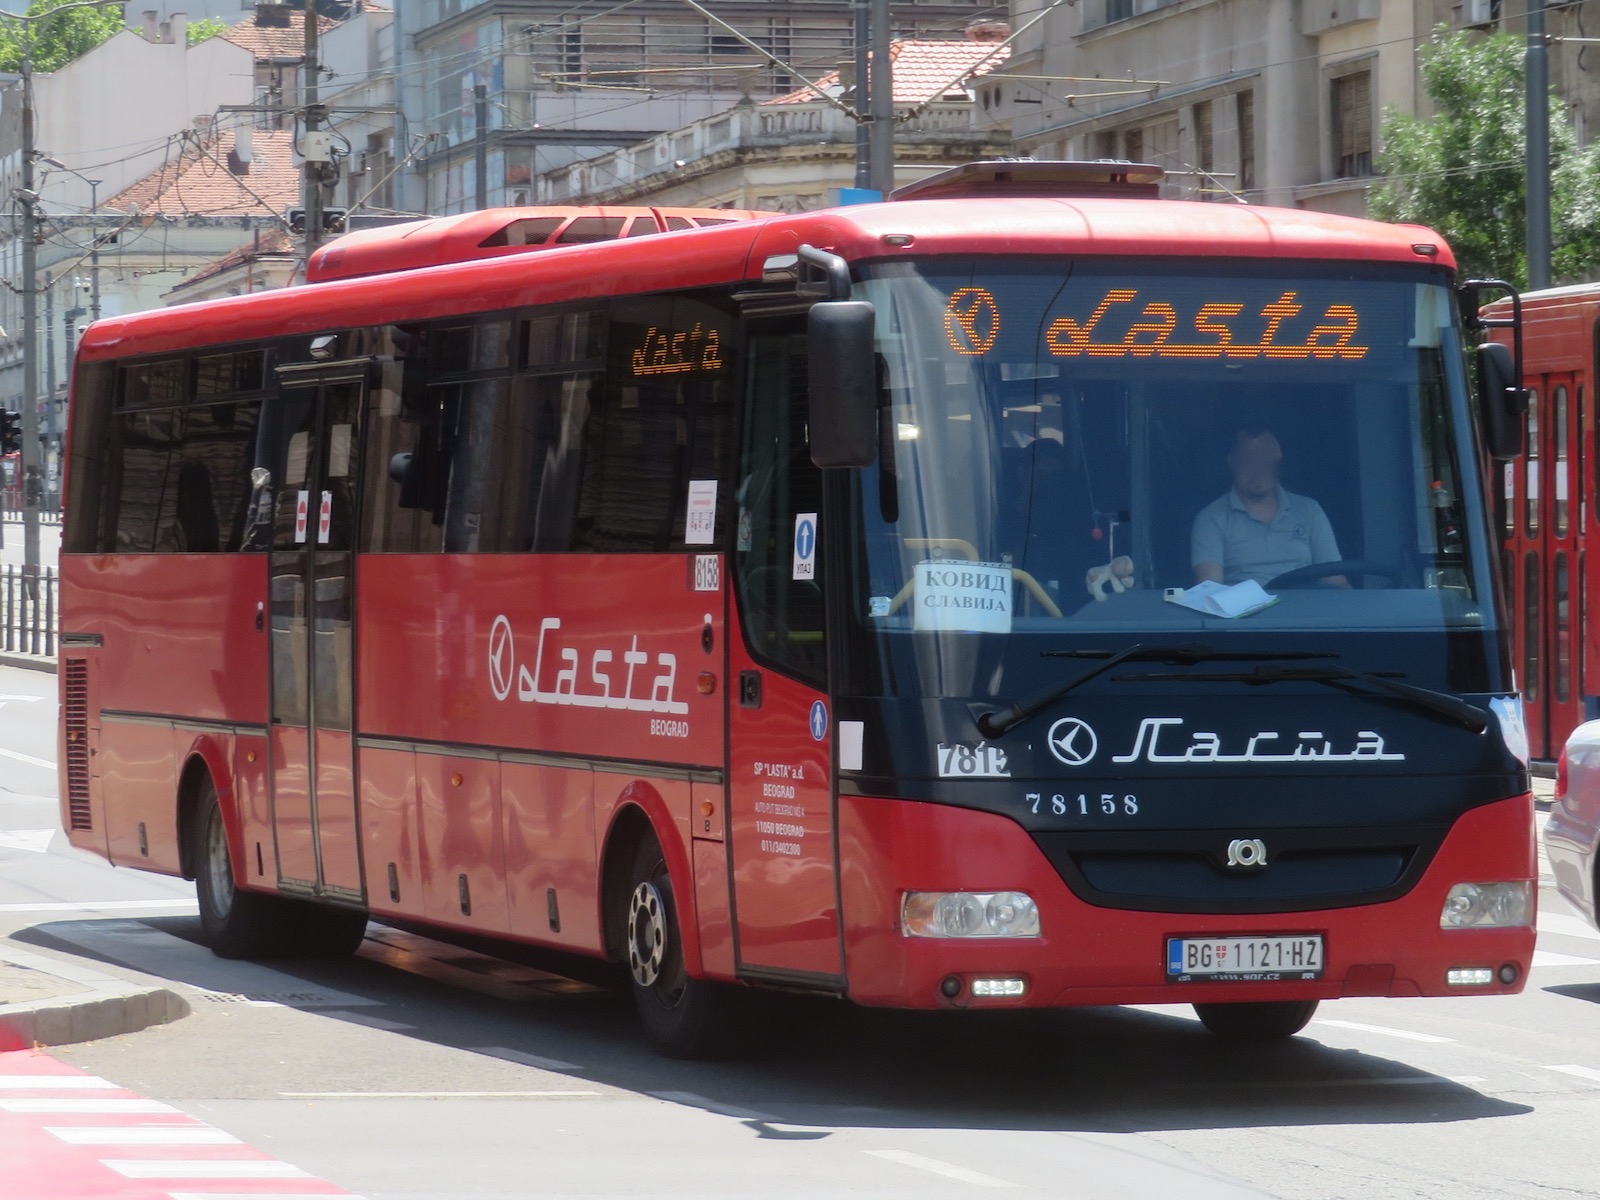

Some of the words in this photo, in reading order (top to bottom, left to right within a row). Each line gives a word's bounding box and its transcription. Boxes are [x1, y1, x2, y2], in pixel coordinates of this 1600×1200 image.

[1045, 288, 1369, 359] Lasta
[632, 322, 722, 376] Lasta
[696, 558, 718, 588] 8158
[925, 570, 1007, 595] КОВИД
[923, 595, 1006, 612] СЛАВИЈА
[518, 617, 689, 715] Lasta
[650, 718, 689, 738] BEOGRAD
[1112, 717, 1405, 763] Ласта
[754, 762, 763, 775] SP
[763, 783, 795, 799] BEOGRAD
[1025, 792, 1139, 815] 78158
[775, 822, 804, 837] BEOGRAD
[1188, 943, 1212, 968] BG
